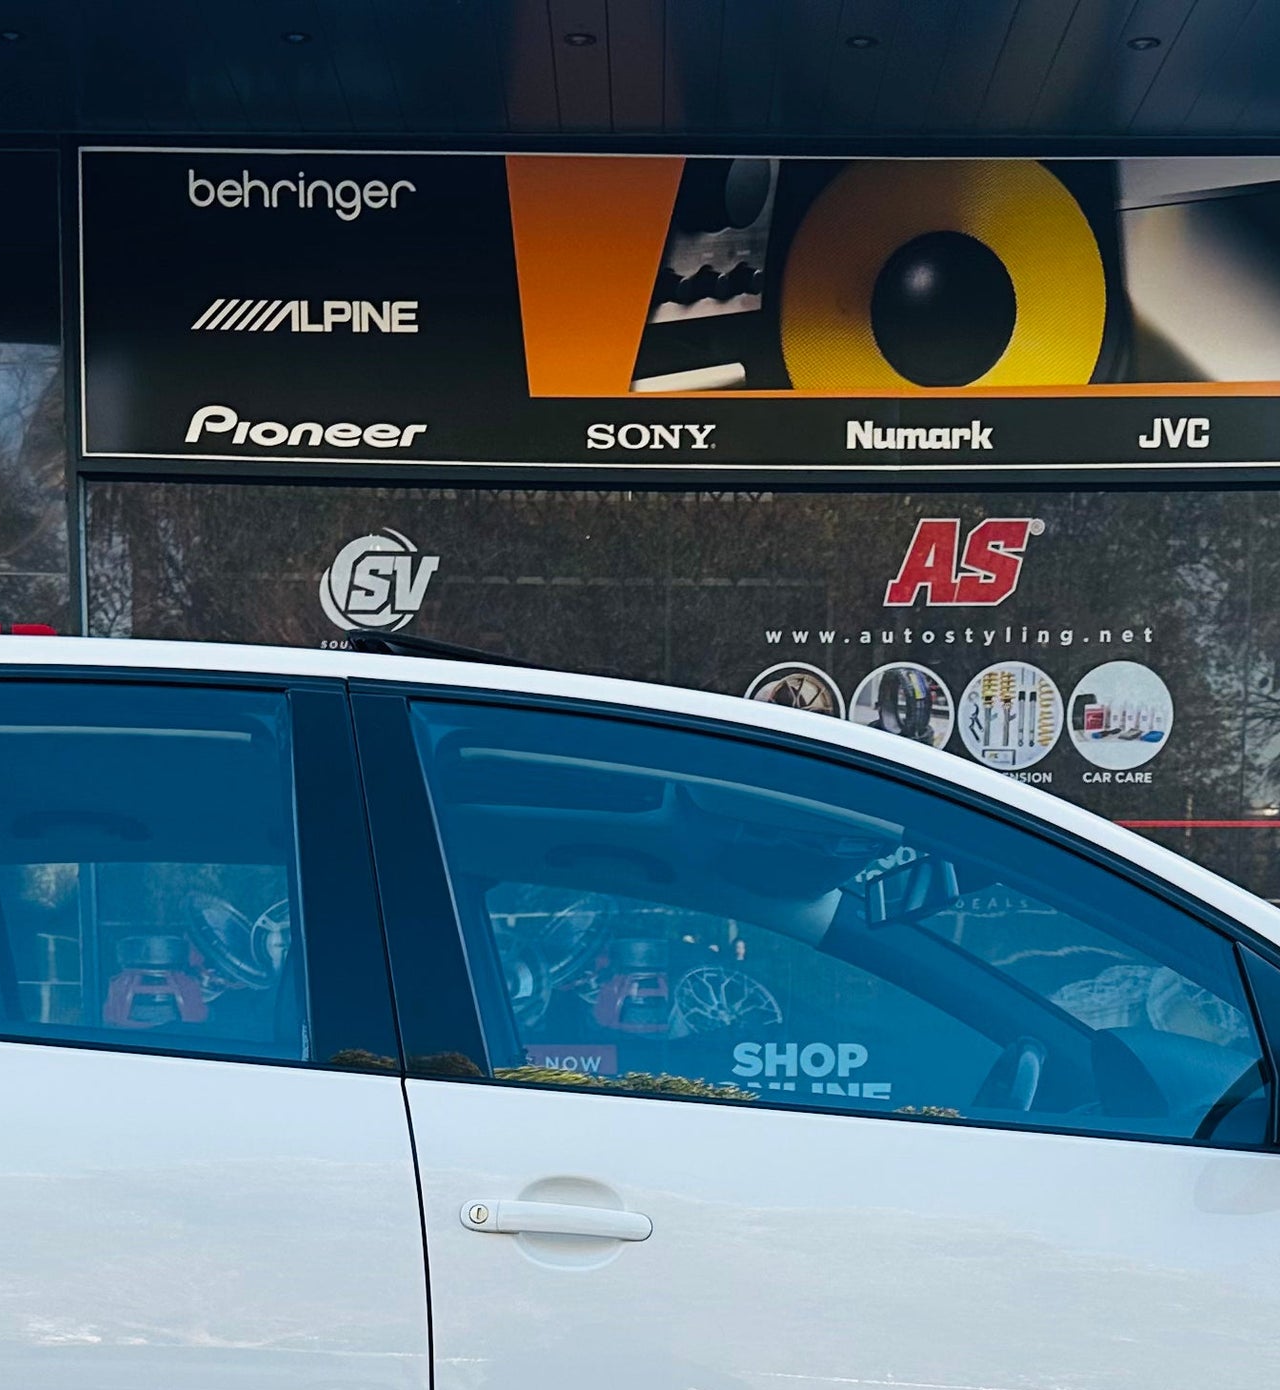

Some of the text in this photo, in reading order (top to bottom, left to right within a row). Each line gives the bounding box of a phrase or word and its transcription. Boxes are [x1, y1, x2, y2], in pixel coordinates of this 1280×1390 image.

[189, 169, 416, 221] behringer
[263, 298, 420, 334] ALPINE
[185, 406, 427, 447] Pioneer
[588, 424, 715, 449] SONY
[847, 421, 993, 449] Numark
[1139, 418, 1209, 448] JVC
[349, 556, 439, 610] SV
[766, 627, 1152, 646] www.autostyling.net
[1083, 769, 1152, 783] CAR CARE
[731, 1041, 869, 1078] SHOP
